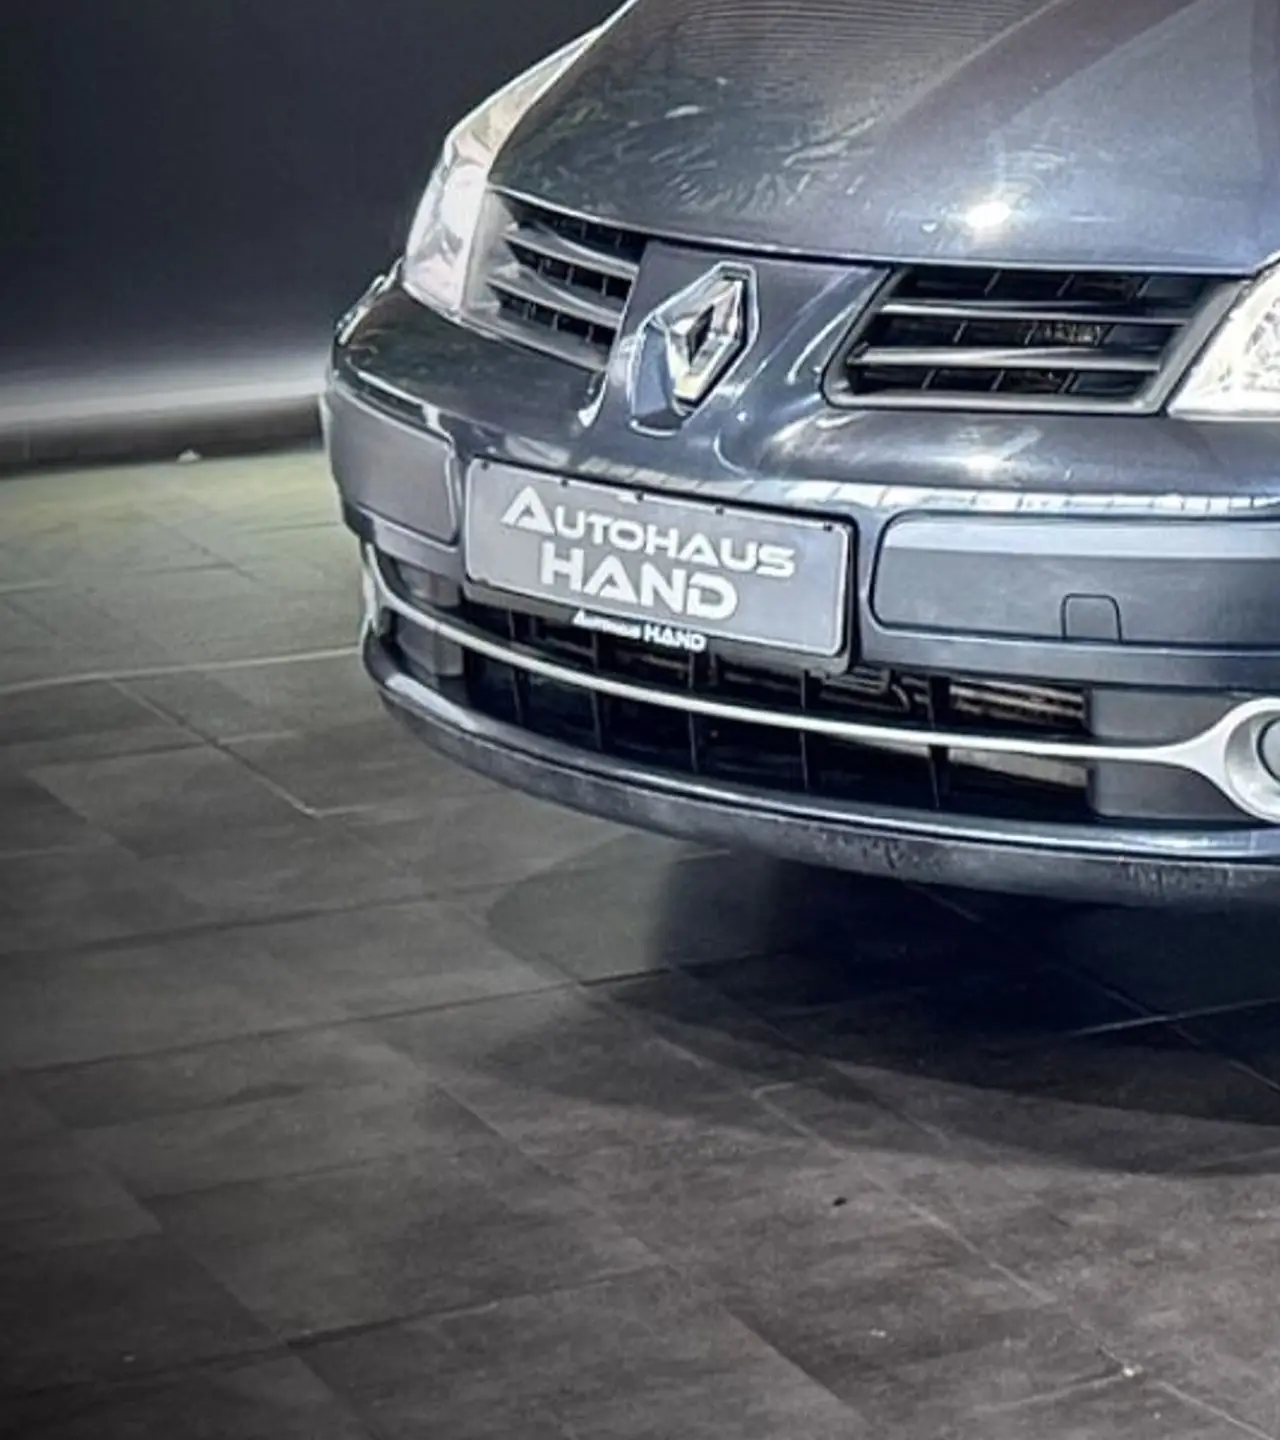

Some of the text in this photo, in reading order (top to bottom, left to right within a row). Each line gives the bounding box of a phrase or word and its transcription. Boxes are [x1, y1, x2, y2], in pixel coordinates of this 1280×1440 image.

[500, 485, 796, 579] AUTOHAUS
[540, 540, 739, 621] HAND
[643, 622, 708, 653] HAND
